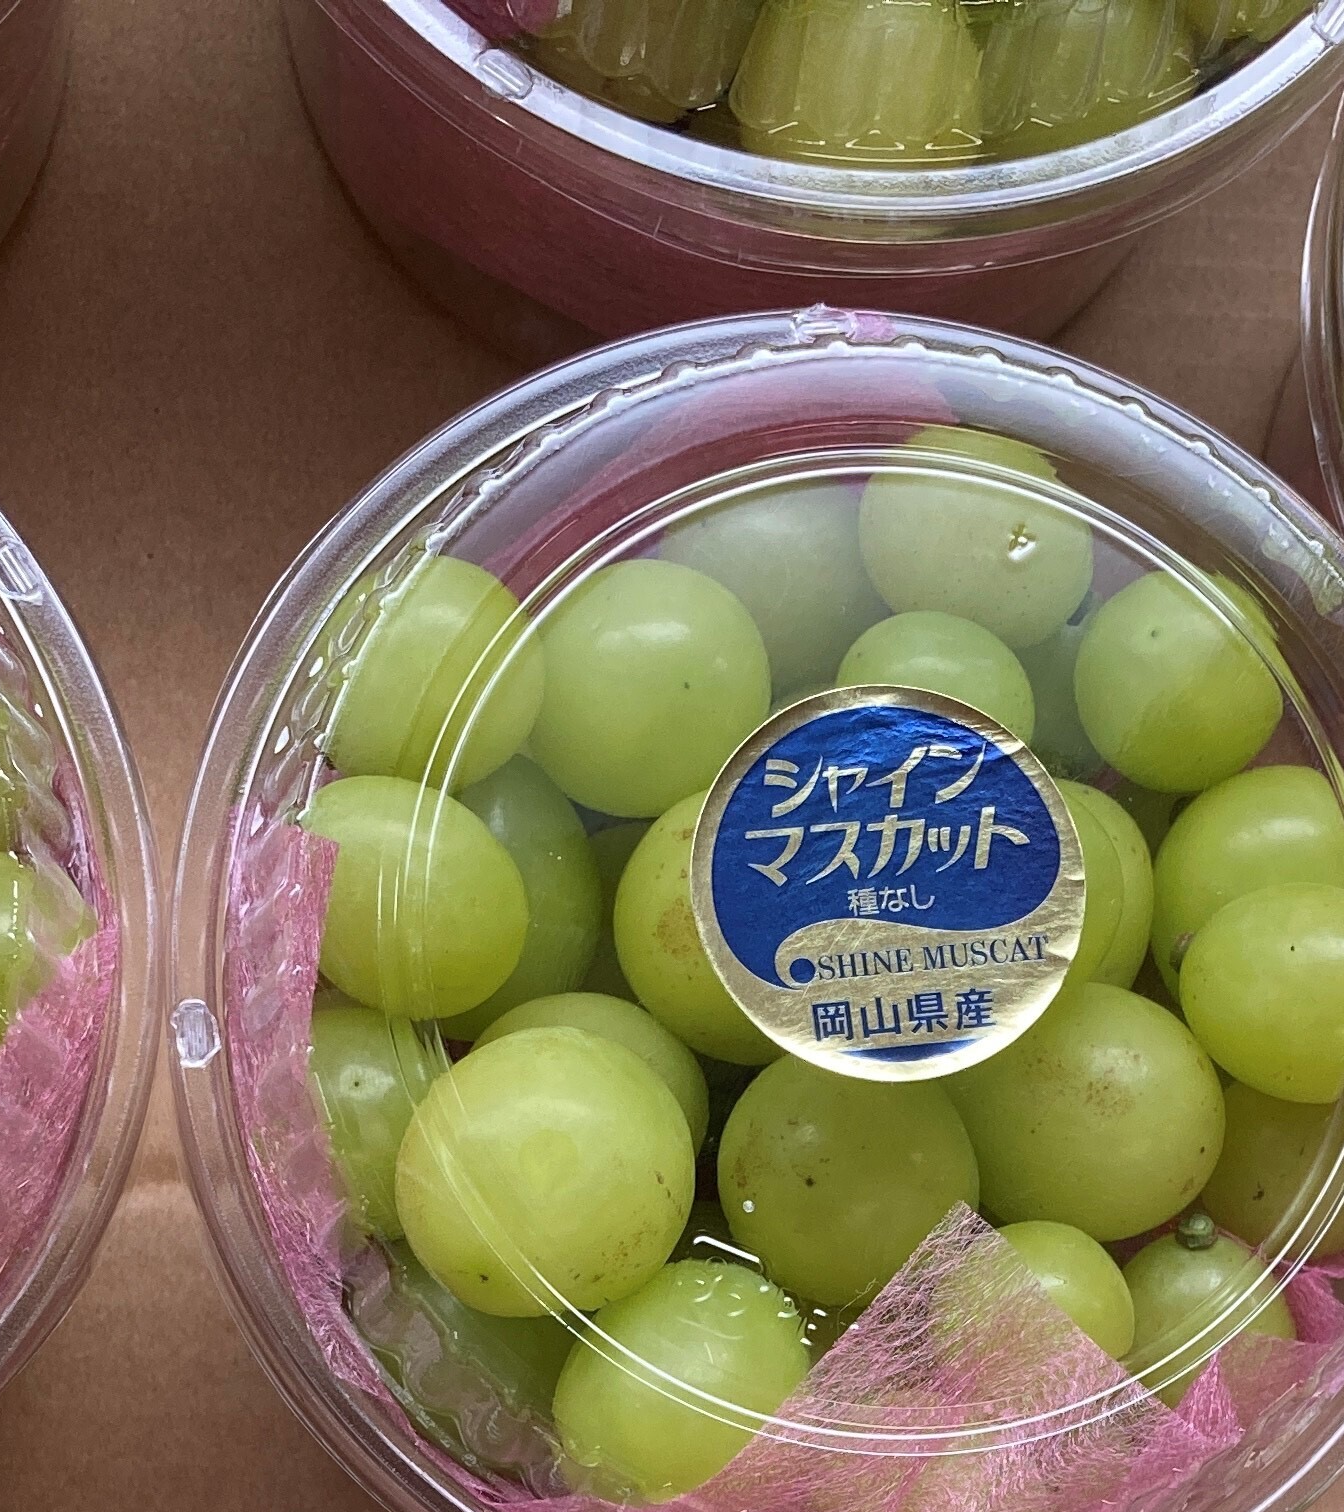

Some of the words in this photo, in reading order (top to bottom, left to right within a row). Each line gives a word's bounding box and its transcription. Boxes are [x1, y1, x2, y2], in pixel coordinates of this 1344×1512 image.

[763, 743, 987, 817] シャイン
[745, 806, 1030, 887] マスカット
[847, 885, 936, 916] 種なし
[817, 948, 913, 981] SHINE
[921, 935, 1049, 971] MUSCAT
[812, 988, 998, 1042] 岡山県産
